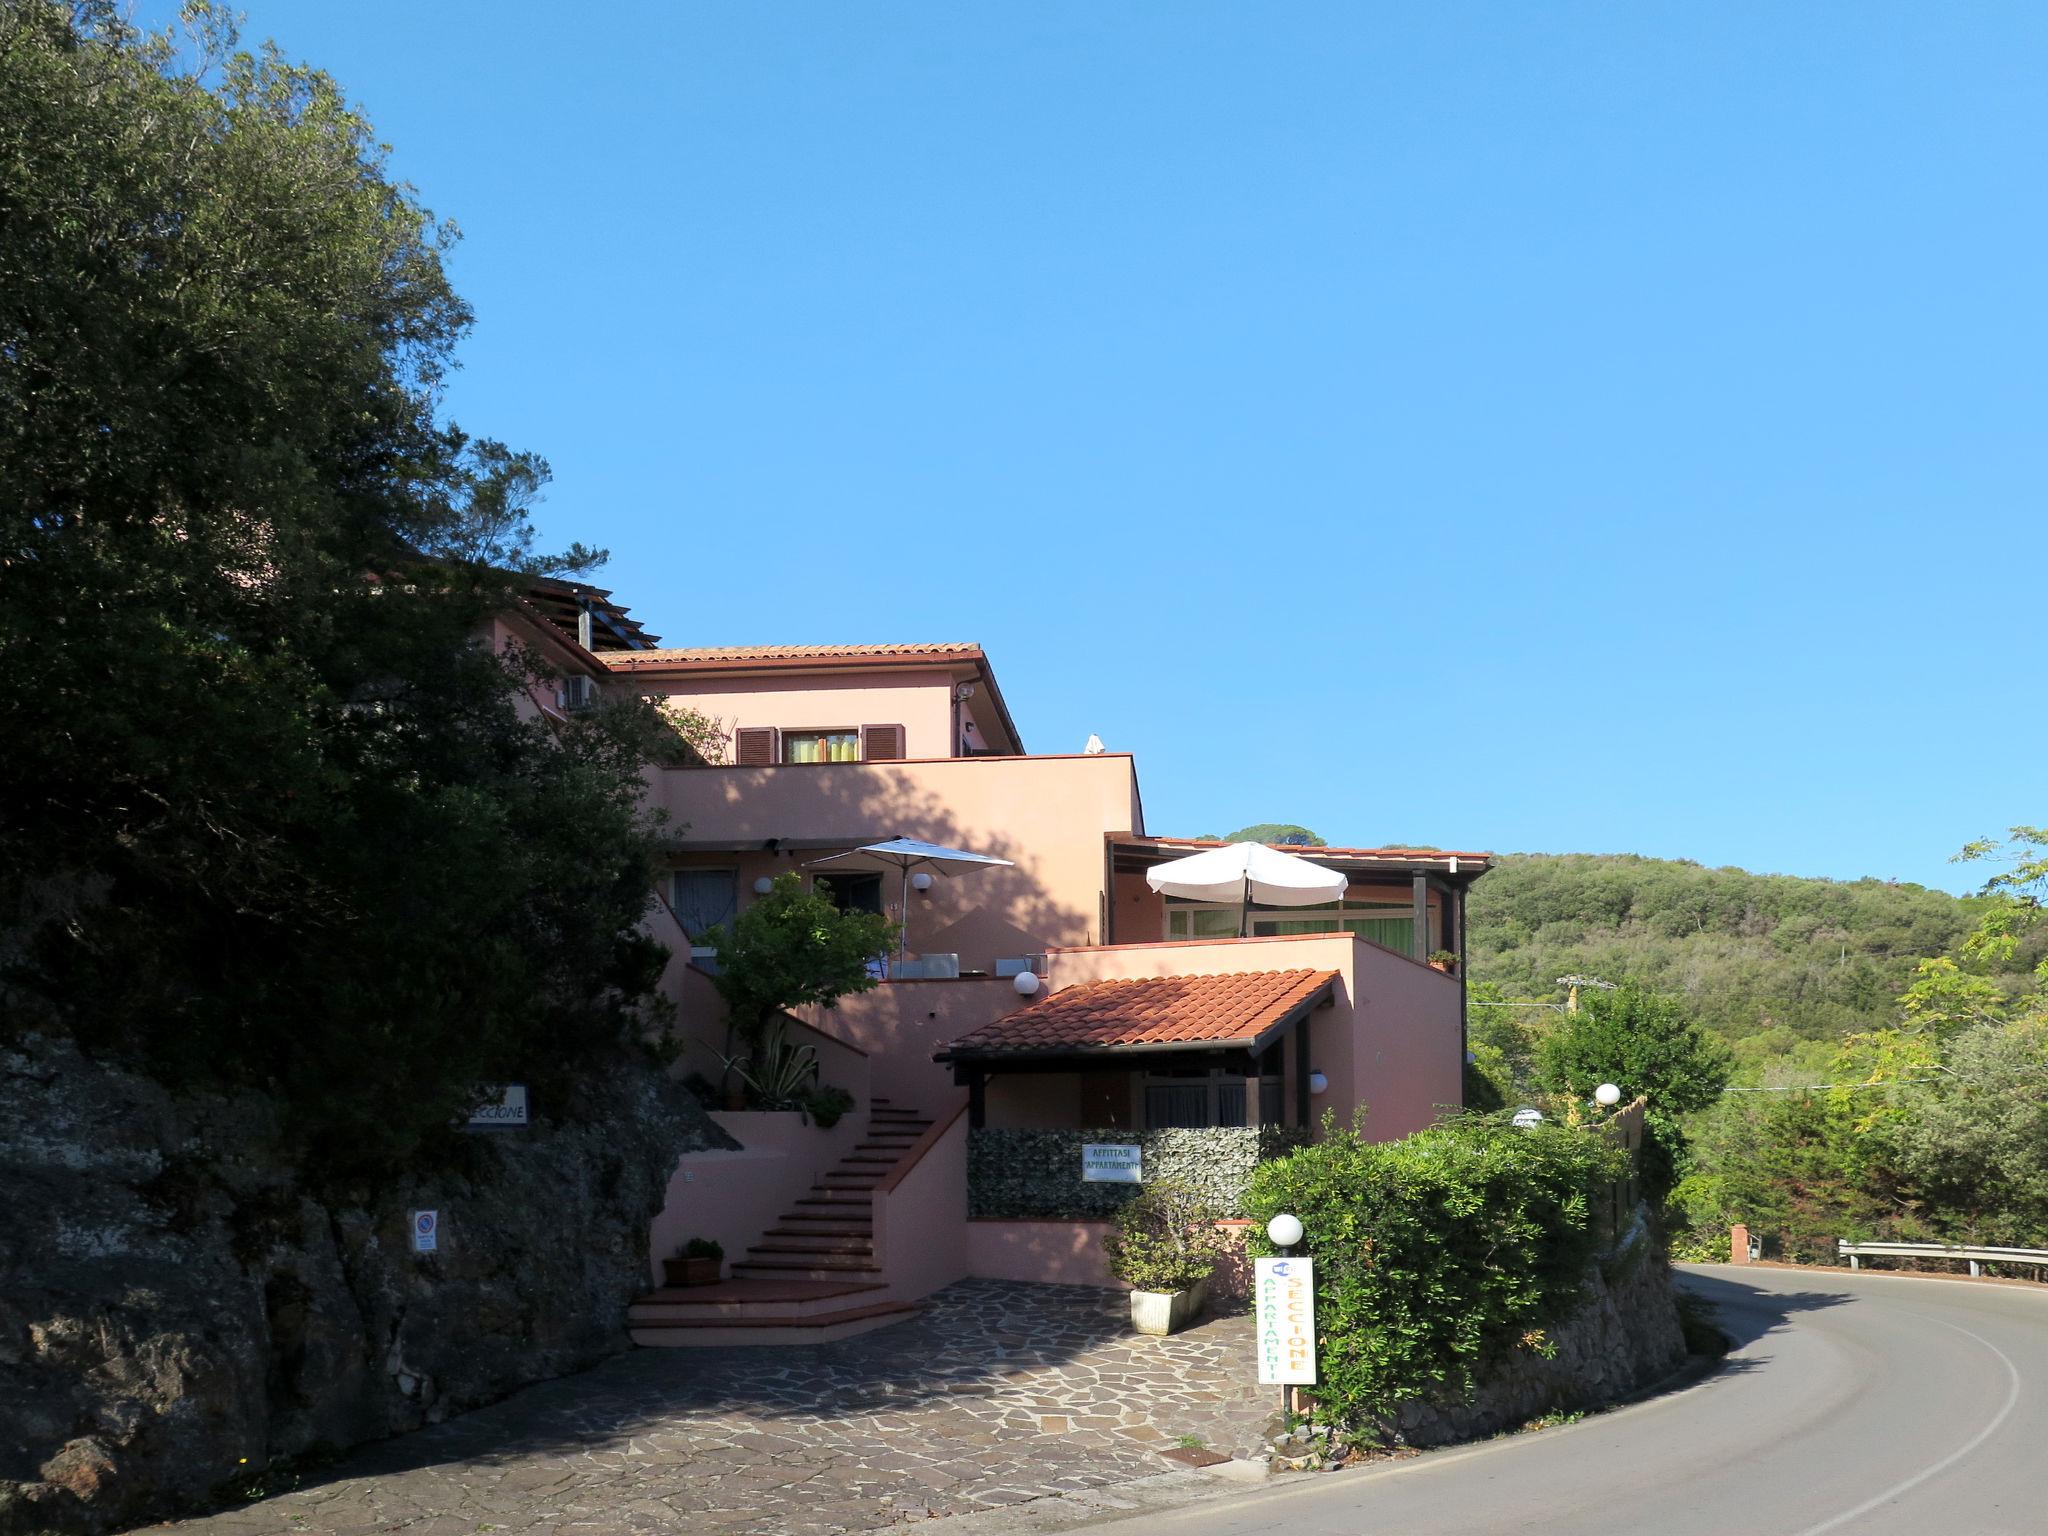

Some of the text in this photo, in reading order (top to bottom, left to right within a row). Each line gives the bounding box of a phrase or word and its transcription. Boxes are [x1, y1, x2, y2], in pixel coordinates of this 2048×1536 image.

[467, 1106, 524, 1119] ECCIONE
[1093, 1149, 1130, 1157] AFFITTASI
[1264, 1278, 1280, 1380] APPARTAMENTI
[1287, 1278, 1307, 1370] SECCIONE
